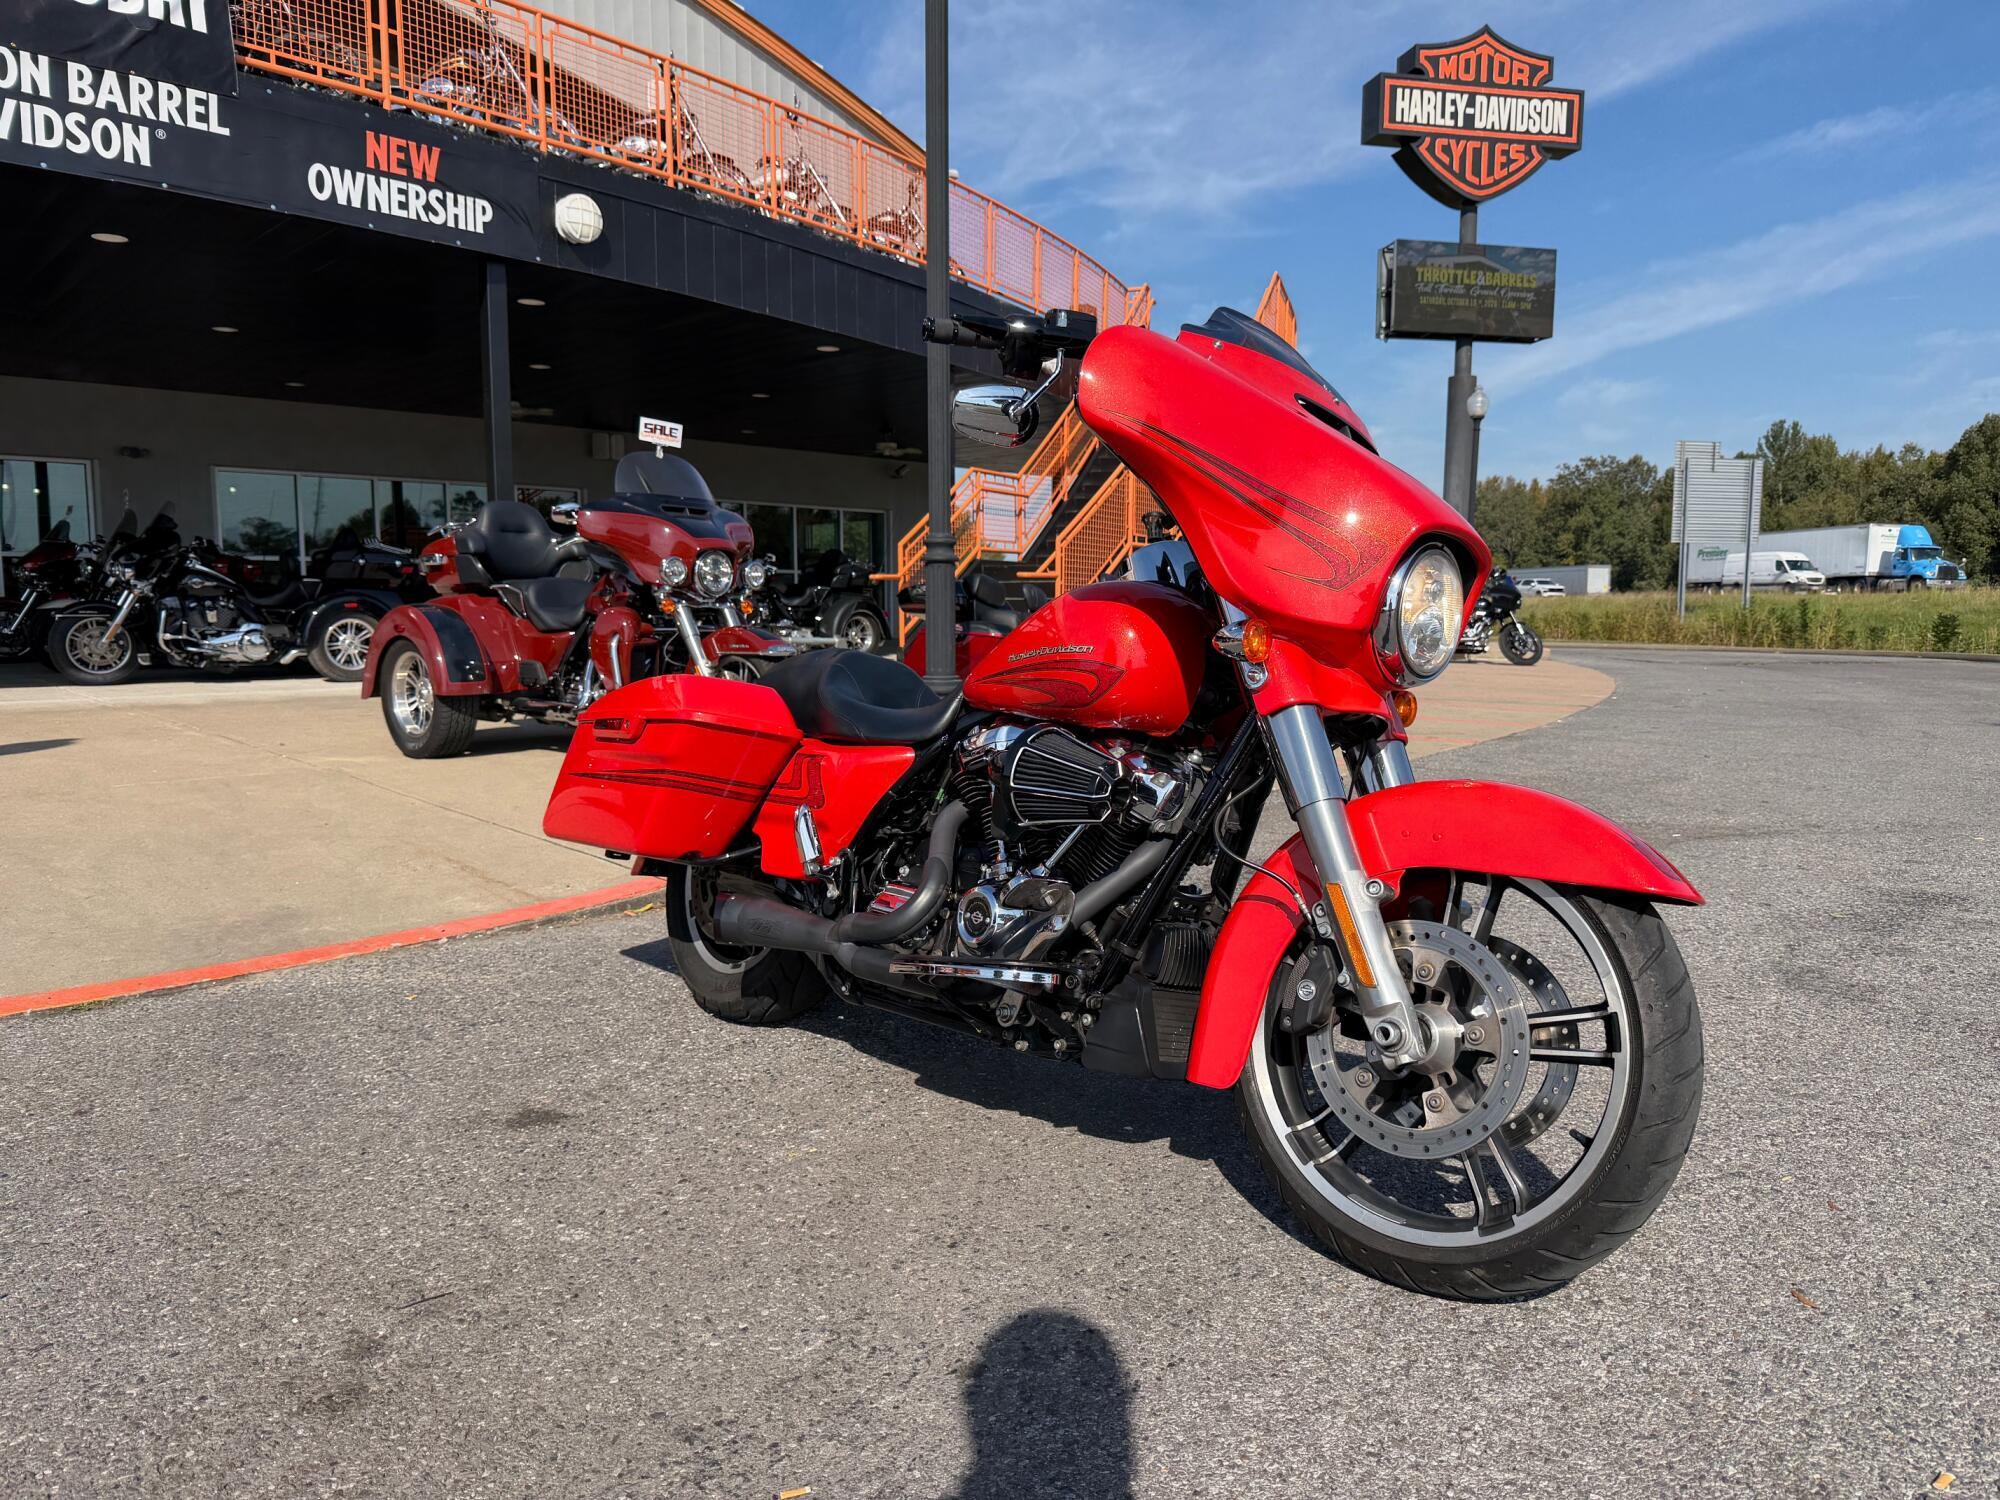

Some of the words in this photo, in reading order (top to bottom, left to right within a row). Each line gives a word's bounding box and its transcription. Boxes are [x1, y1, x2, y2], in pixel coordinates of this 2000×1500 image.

[1439, 44, 1530, 86] MOTOR
[67, 60, 231, 136] BARREL
[1395, 87, 1568, 135] HARLEY-DAVIDSON
[365, 130, 441, 182] NEW
[1435, 137, 1526, 186] CYCLES
[307, 162, 494, 234] OWNERSHIP
[644, 423, 679, 438] SALE
